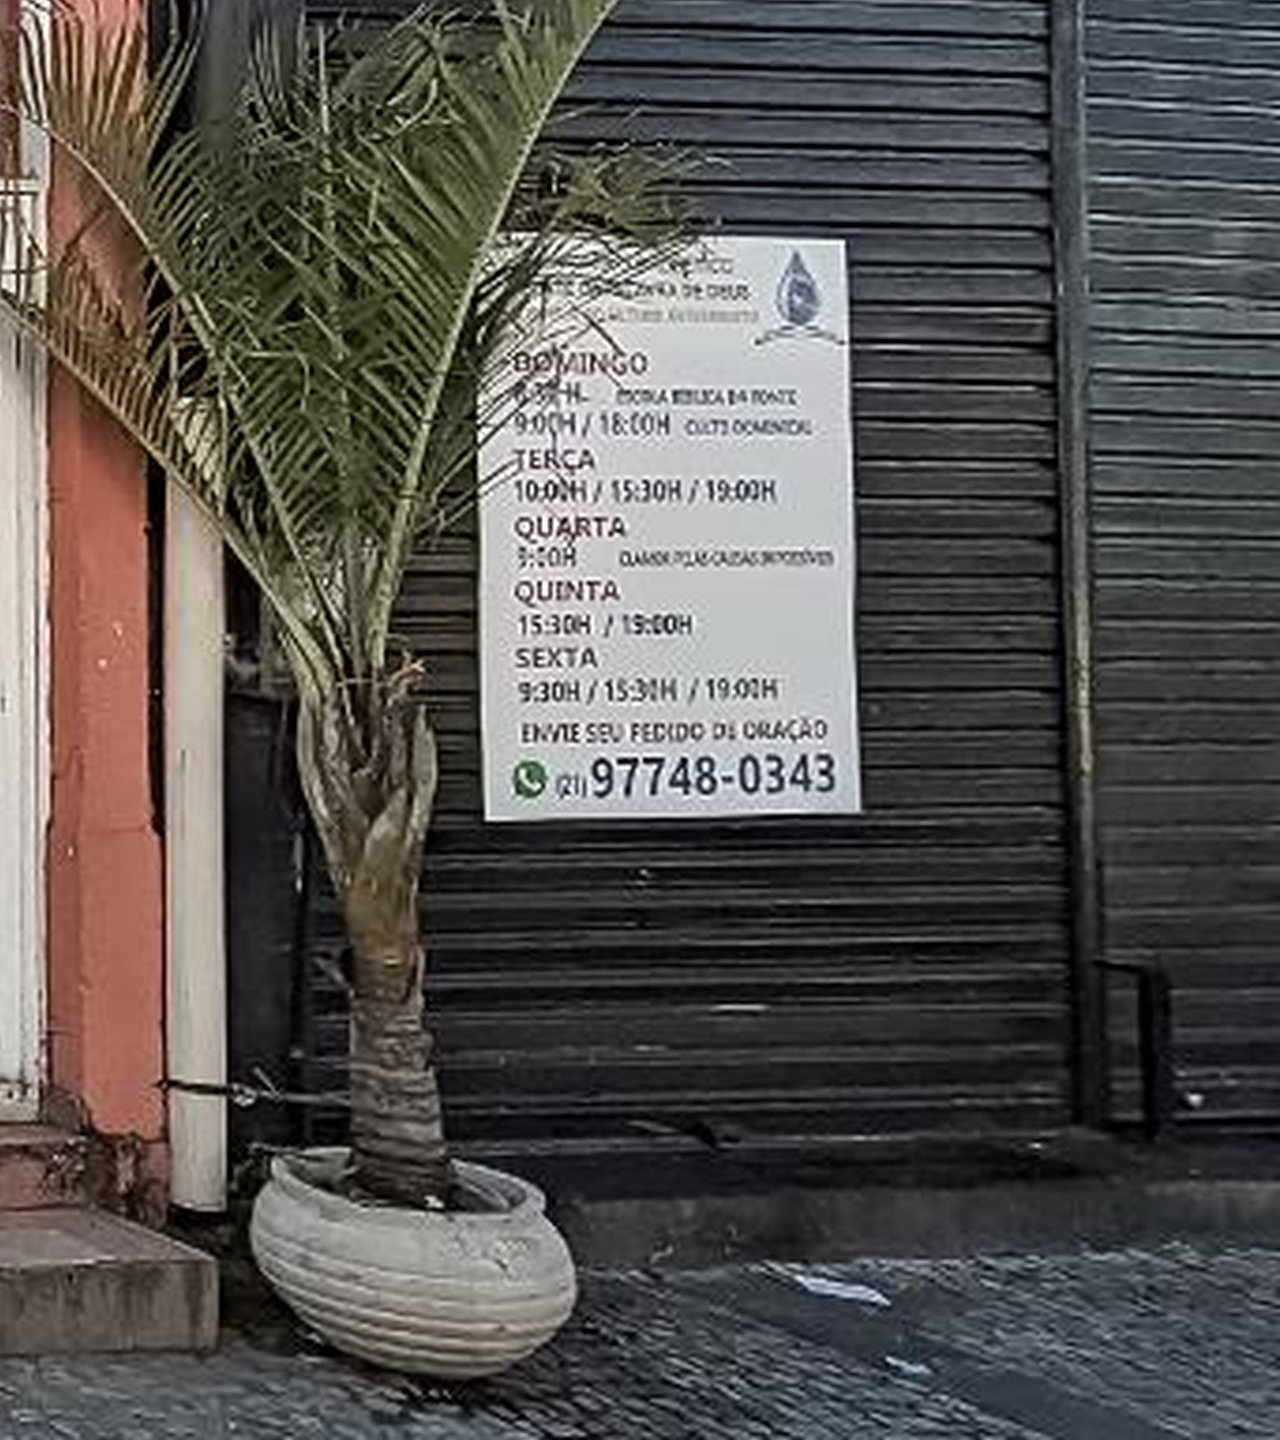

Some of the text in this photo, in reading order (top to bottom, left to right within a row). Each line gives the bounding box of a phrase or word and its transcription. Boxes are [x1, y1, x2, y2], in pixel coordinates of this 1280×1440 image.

[513, 351, 648, 376] DOMINGO
[513, 449, 595, 475] TERÇA
[611, 480, 681, 503] 15:30H
[706, 479, 777, 502] 19:00H
[514, 516, 627, 541] QUARTA
[514, 580, 621, 607] QUINTA
[518, 614, 591, 636] 15:30H
[515, 647, 598, 669] SEXTA
[518, 680, 580, 703] 9:30H
[605, 679, 677, 702] 15:30H
[707, 677, 778, 701] 19:00H
[522, 722, 581, 744] ENVIE
[629, 721, 705, 743] PEDIDO
[743, 718, 828, 743] ORAÇÃO
[556, 754, 837, 799] (21) 97748-0343
